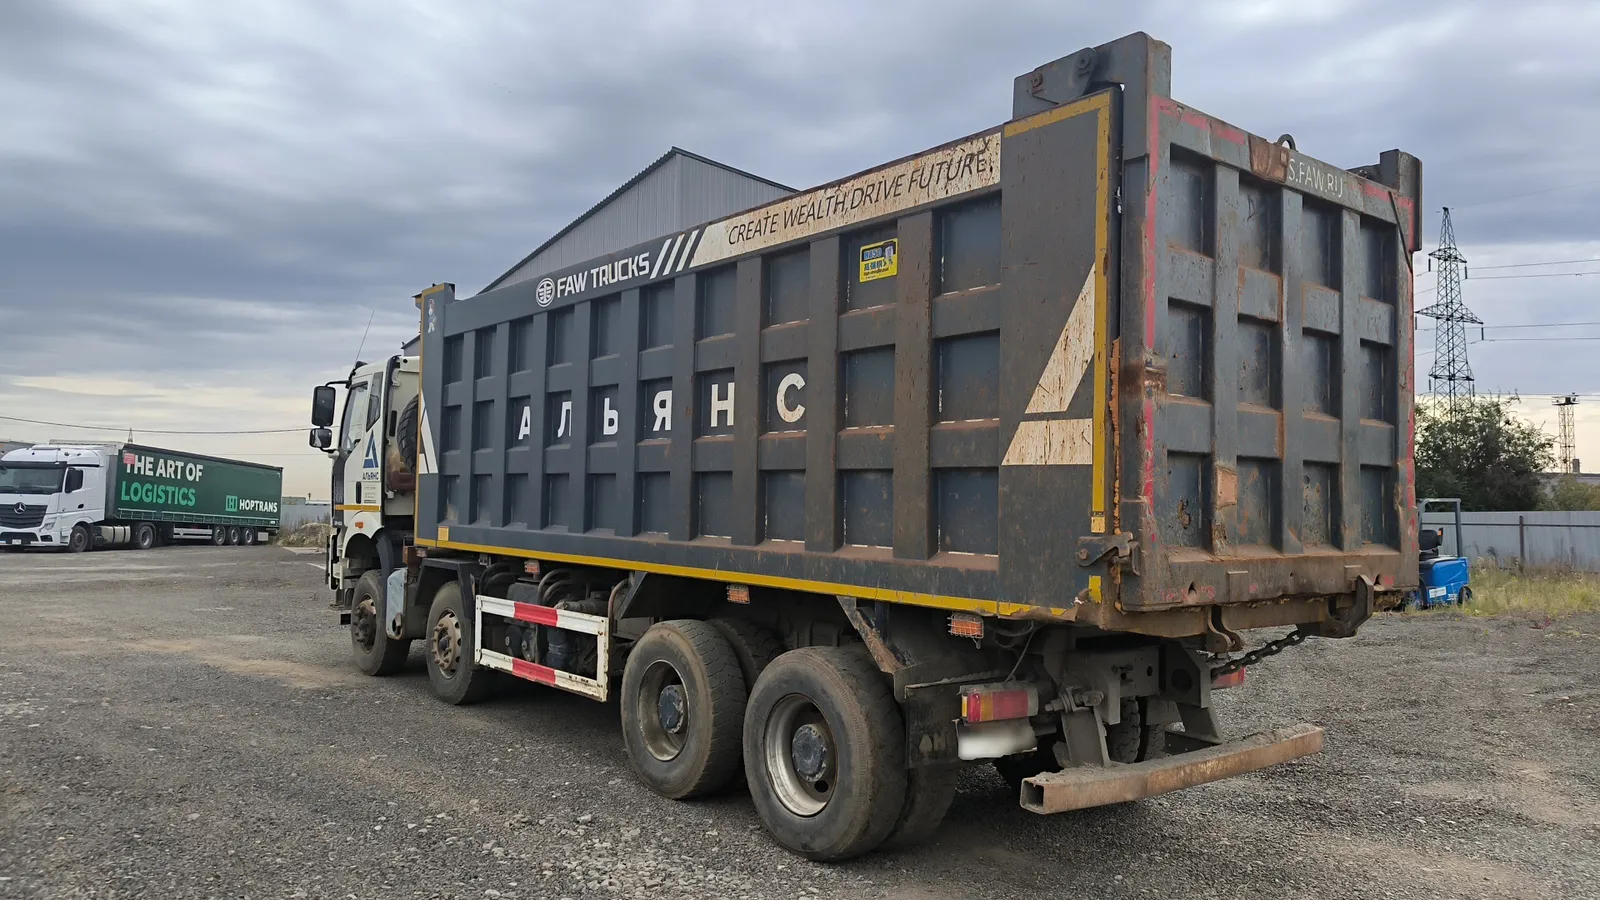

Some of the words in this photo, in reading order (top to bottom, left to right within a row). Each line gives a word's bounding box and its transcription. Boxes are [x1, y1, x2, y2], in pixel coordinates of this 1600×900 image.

[727, 211, 779, 245] CREATE
[557, 271, 588, 298] FAW
[590, 252, 650, 289] TRUCKS
[155, 458, 184, 480] ART
[186, 462, 204, 482] OF
[121, 481, 196, 506] LOGISTICS
[239, 499, 278, 513] HOPTRANS
